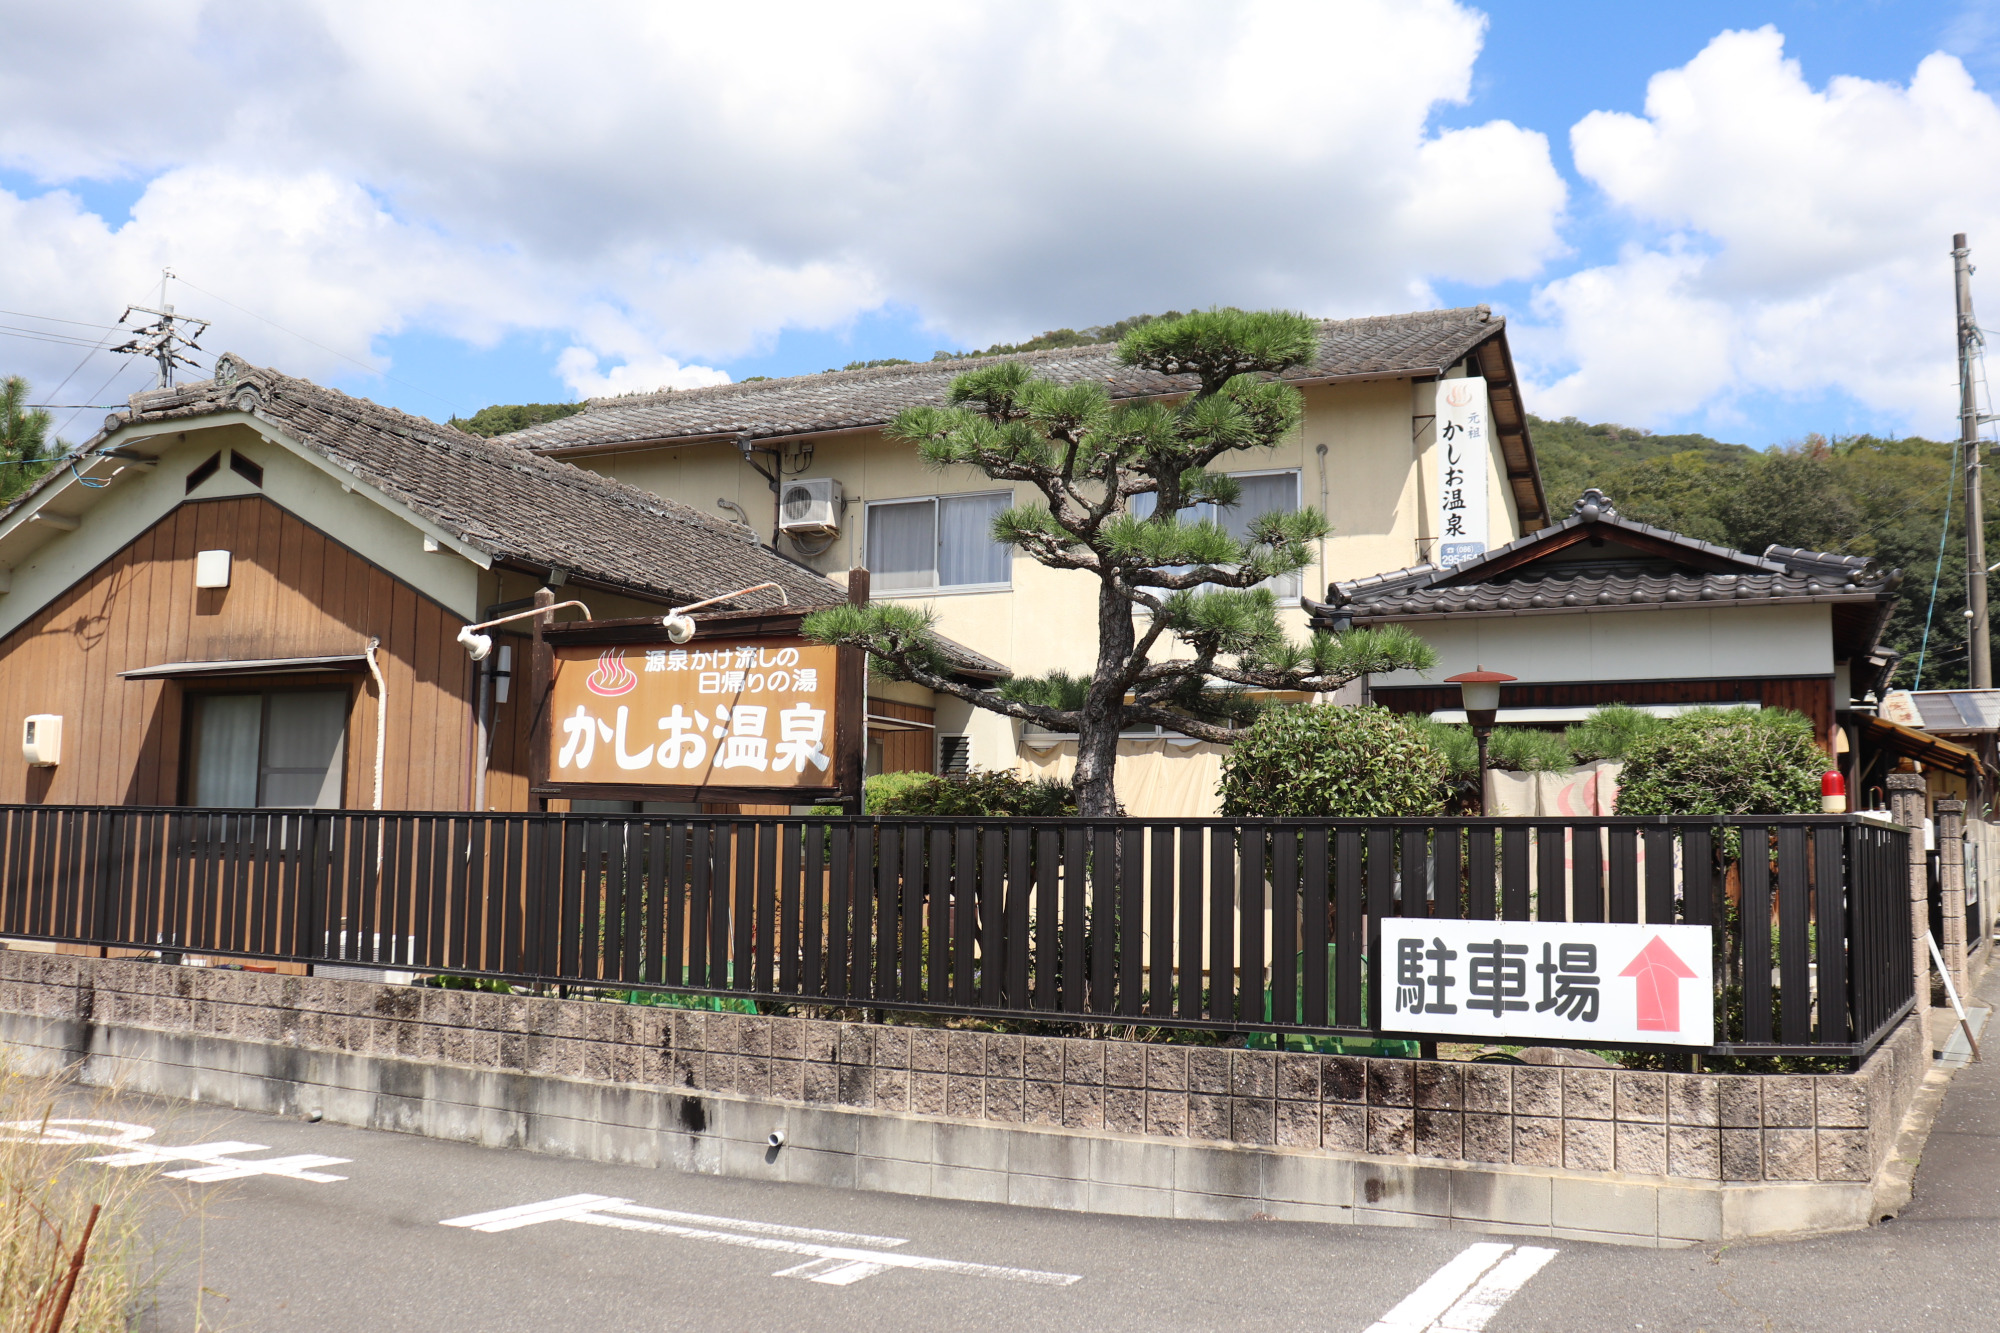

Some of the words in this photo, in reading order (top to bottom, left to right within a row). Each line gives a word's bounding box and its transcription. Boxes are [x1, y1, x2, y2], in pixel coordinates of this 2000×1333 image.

[1467, 412, 1481, 439] 元祖
[1442, 420, 1467, 537] かしお温泉
[644, 647, 799, 673] 源泉かけ流しの
[699, 669, 818, 694] 日帰りの湯
[559, 702, 830, 772] かしお温泉
[1395, 937, 1601, 1022] 駐車場
